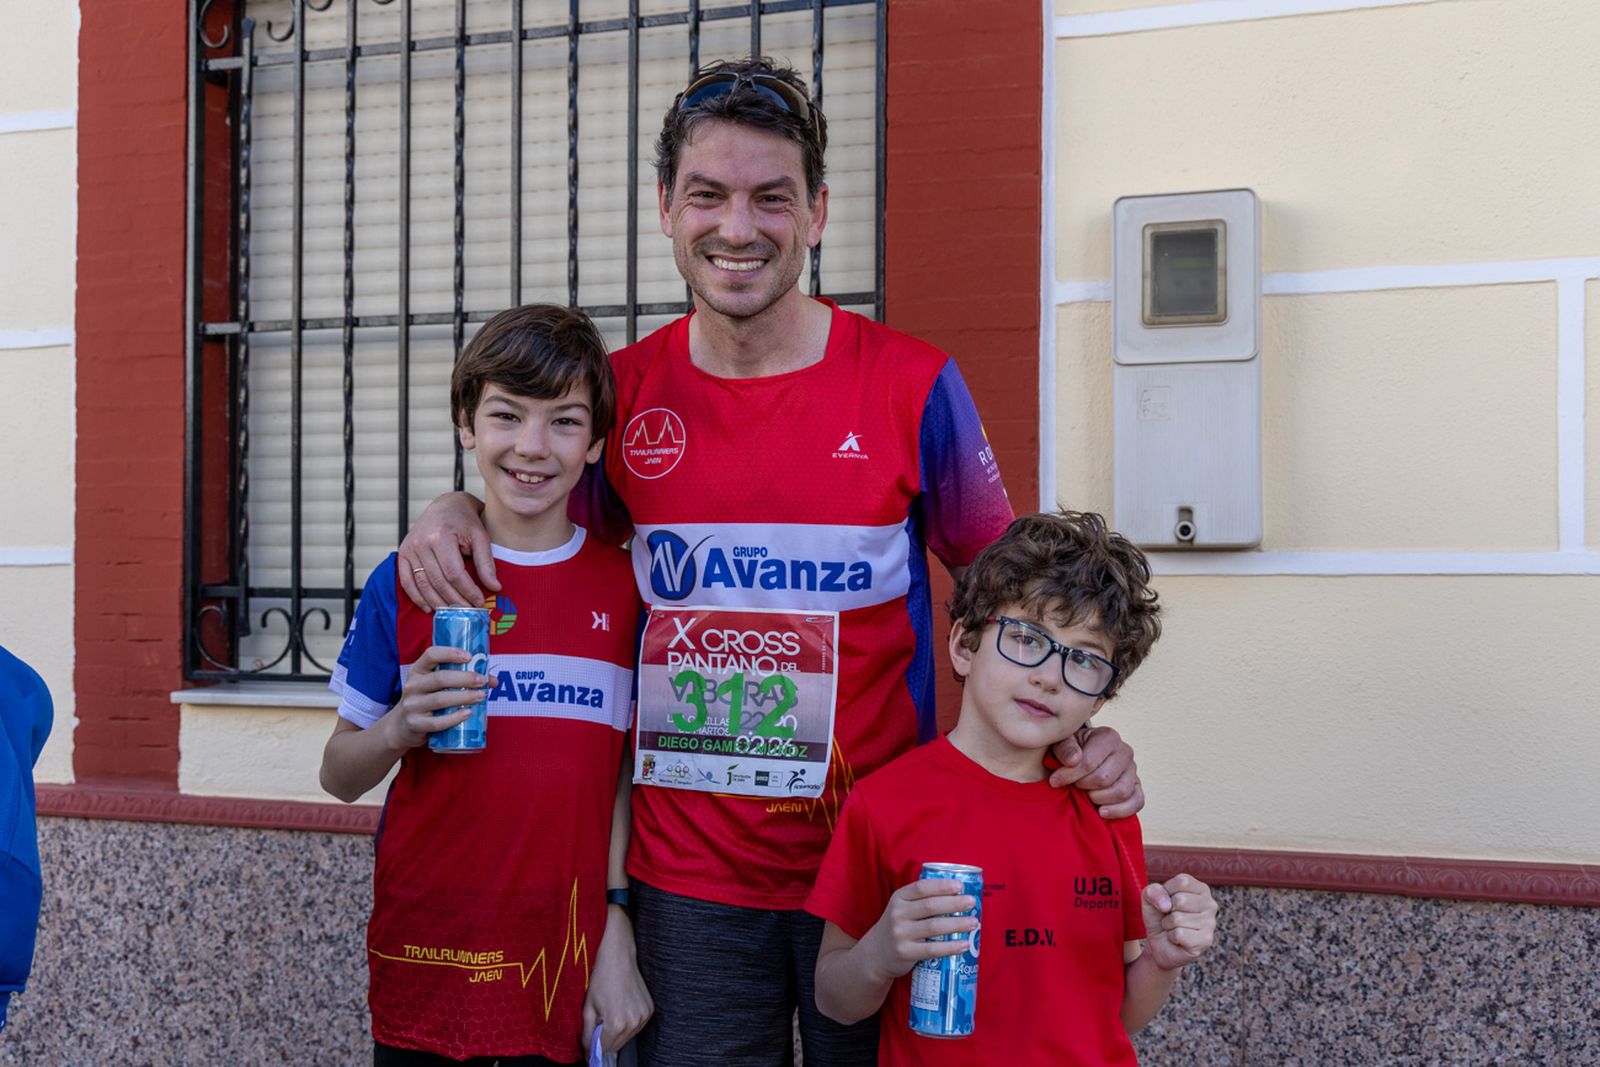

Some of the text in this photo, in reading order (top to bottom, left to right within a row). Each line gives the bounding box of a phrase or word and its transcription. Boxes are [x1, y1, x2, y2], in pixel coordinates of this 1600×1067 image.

[832, 452, 869, 460] EVERNYA
[733, 546, 768, 558] GRUPO
[702, 547, 872, 592] Avanza
[667, 617, 696, 650] X
[702, 629, 800, 656] CROSS
[667, 652, 800, 677] PANTANO DEL
[516, 671, 545, 680] GRUPO
[488, 671, 604, 708] Avanza
[672, 670, 797, 737] 312
[658, 735, 699, 749] DIEGO
[1005, 928, 1056, 947] E.D.V.
[403, 944, 504, 964] TRAILRUNNERS
